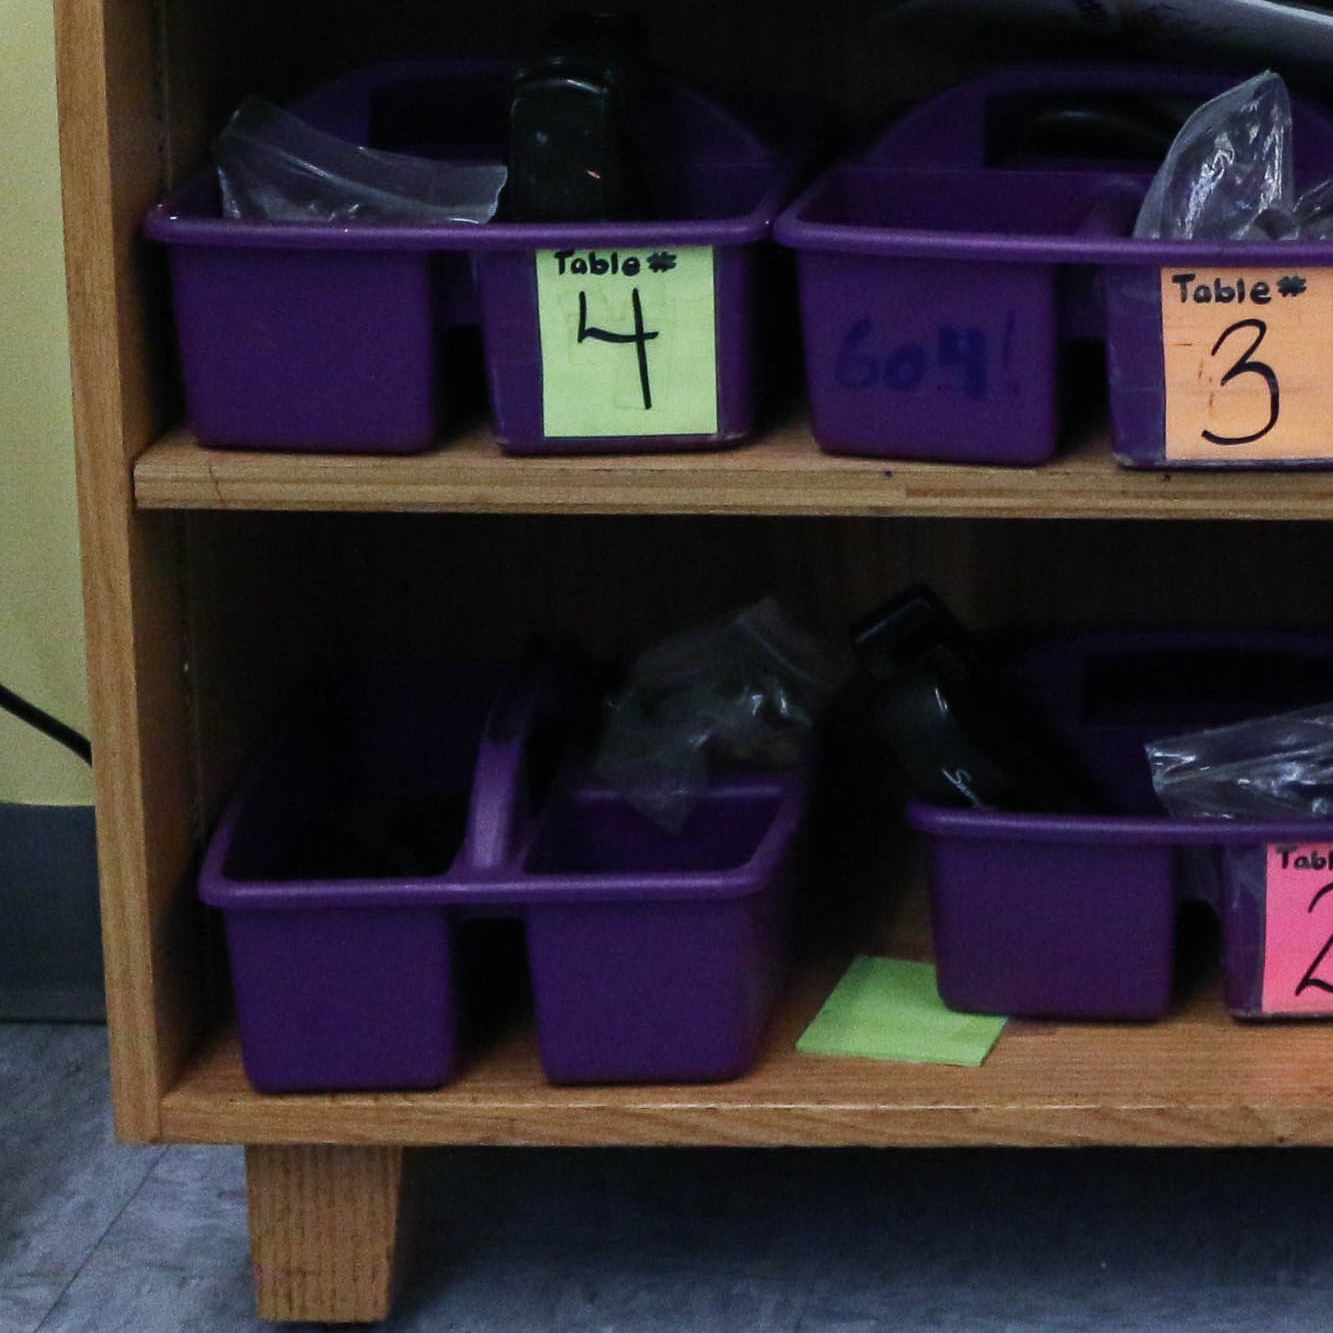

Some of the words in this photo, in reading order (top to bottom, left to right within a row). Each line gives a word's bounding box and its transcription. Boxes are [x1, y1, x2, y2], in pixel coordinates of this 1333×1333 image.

[554, 250, 642, 276] Table
[1171, 273, 1273, 306] Table
[578, 286, 660, 411] 4
[1200, 318, 1280, 447] 3
